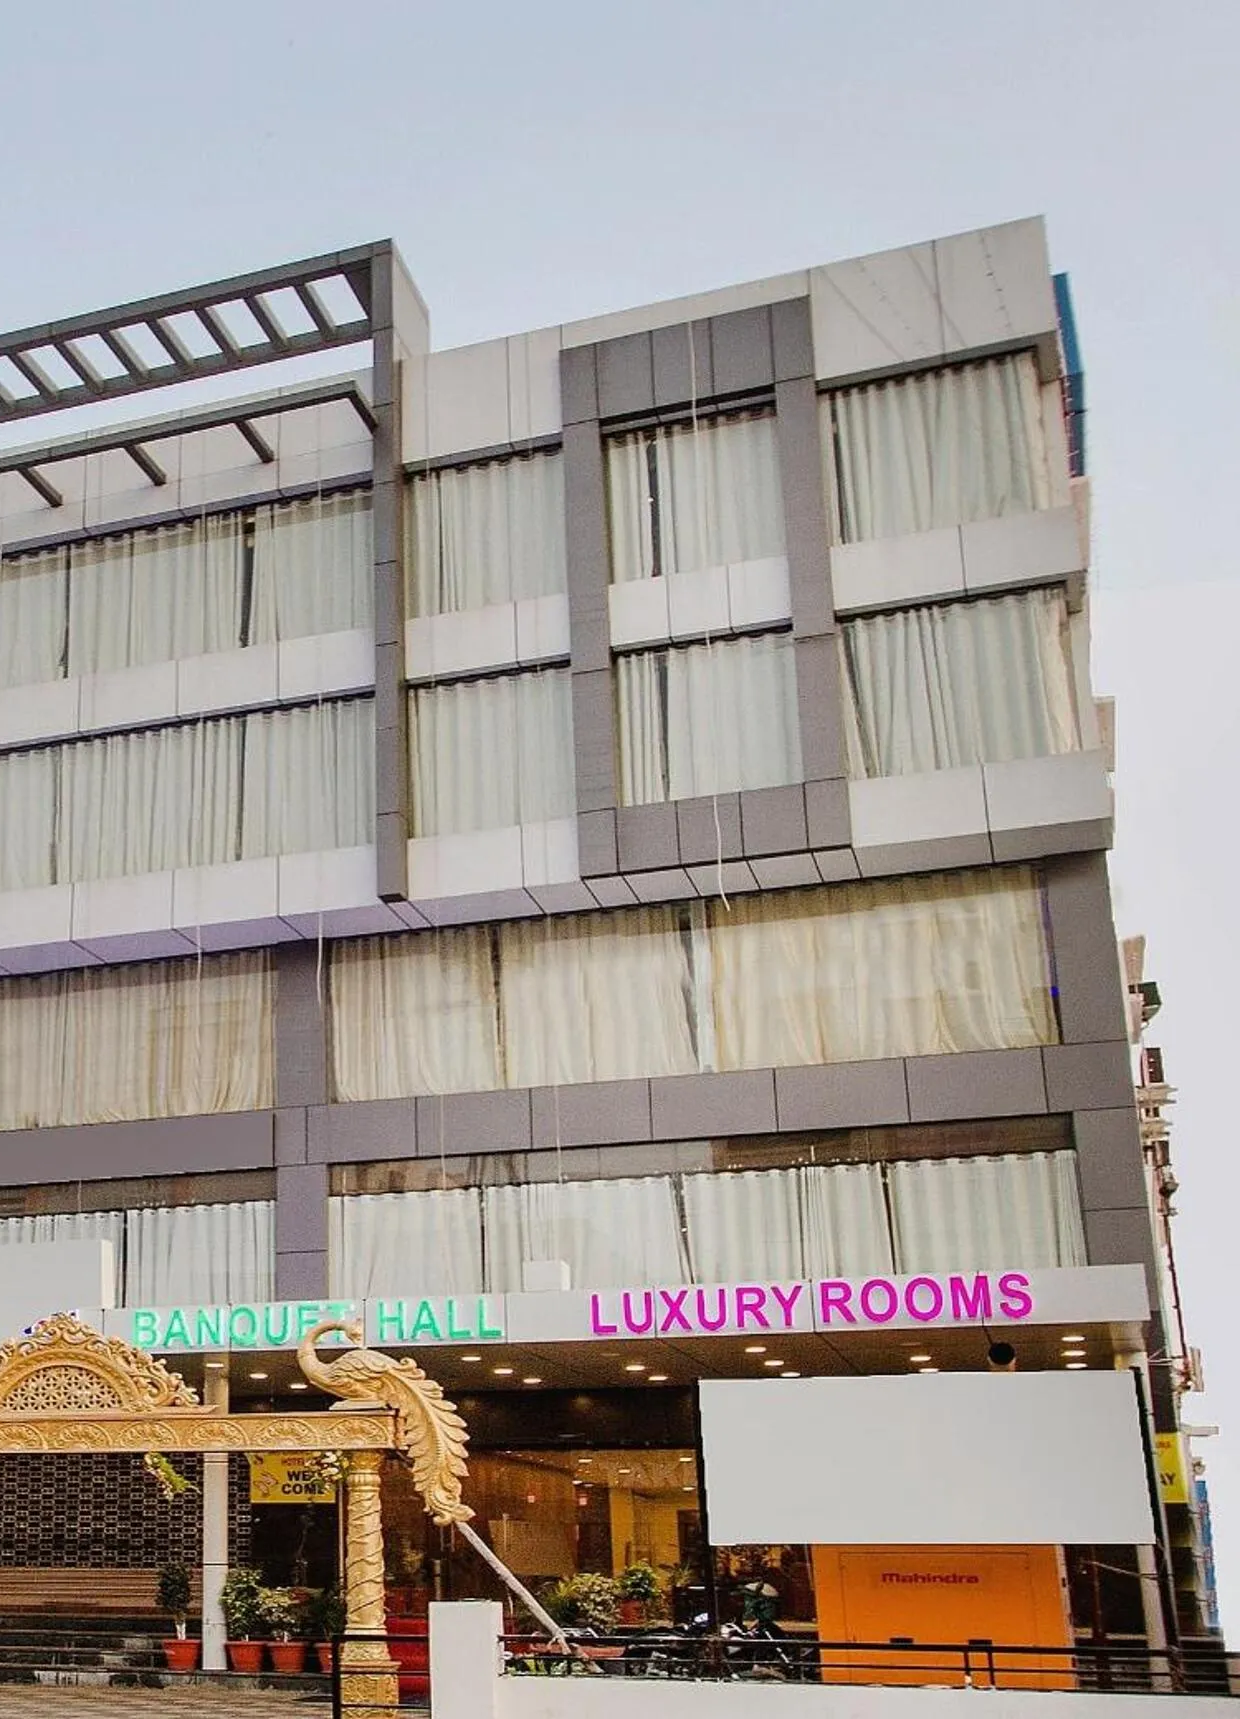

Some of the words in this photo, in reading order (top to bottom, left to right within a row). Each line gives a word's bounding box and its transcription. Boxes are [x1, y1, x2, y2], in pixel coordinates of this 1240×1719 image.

[378, 1298, 503, 1341] HALL
[591, 1284, 803, 1335] LUXURY
[819, 1272, 1034, 1324] ROOMS
